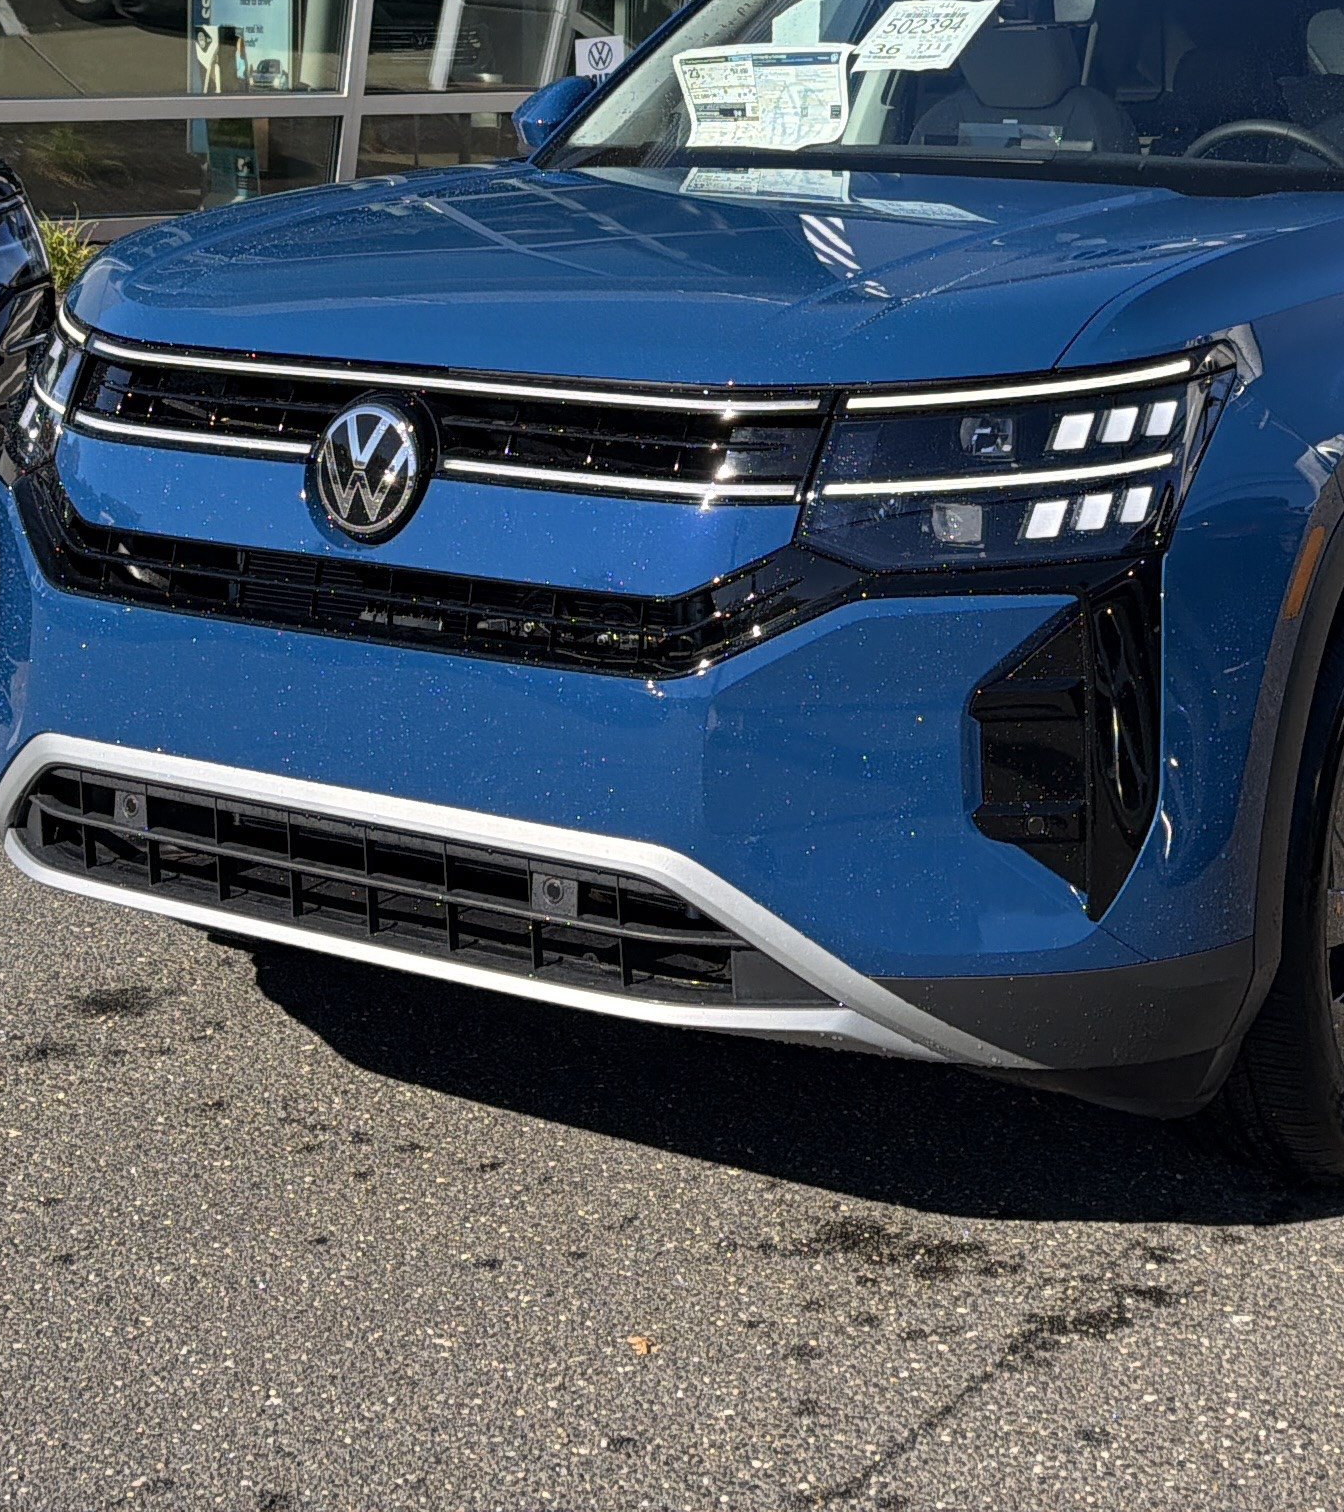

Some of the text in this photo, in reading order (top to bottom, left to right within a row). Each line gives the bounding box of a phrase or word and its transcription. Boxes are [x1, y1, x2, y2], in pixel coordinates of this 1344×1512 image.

[882, 17, 967, 35] 502394
[588, 41, 613, 70] VW
[321, 408, 414, 520] VW
